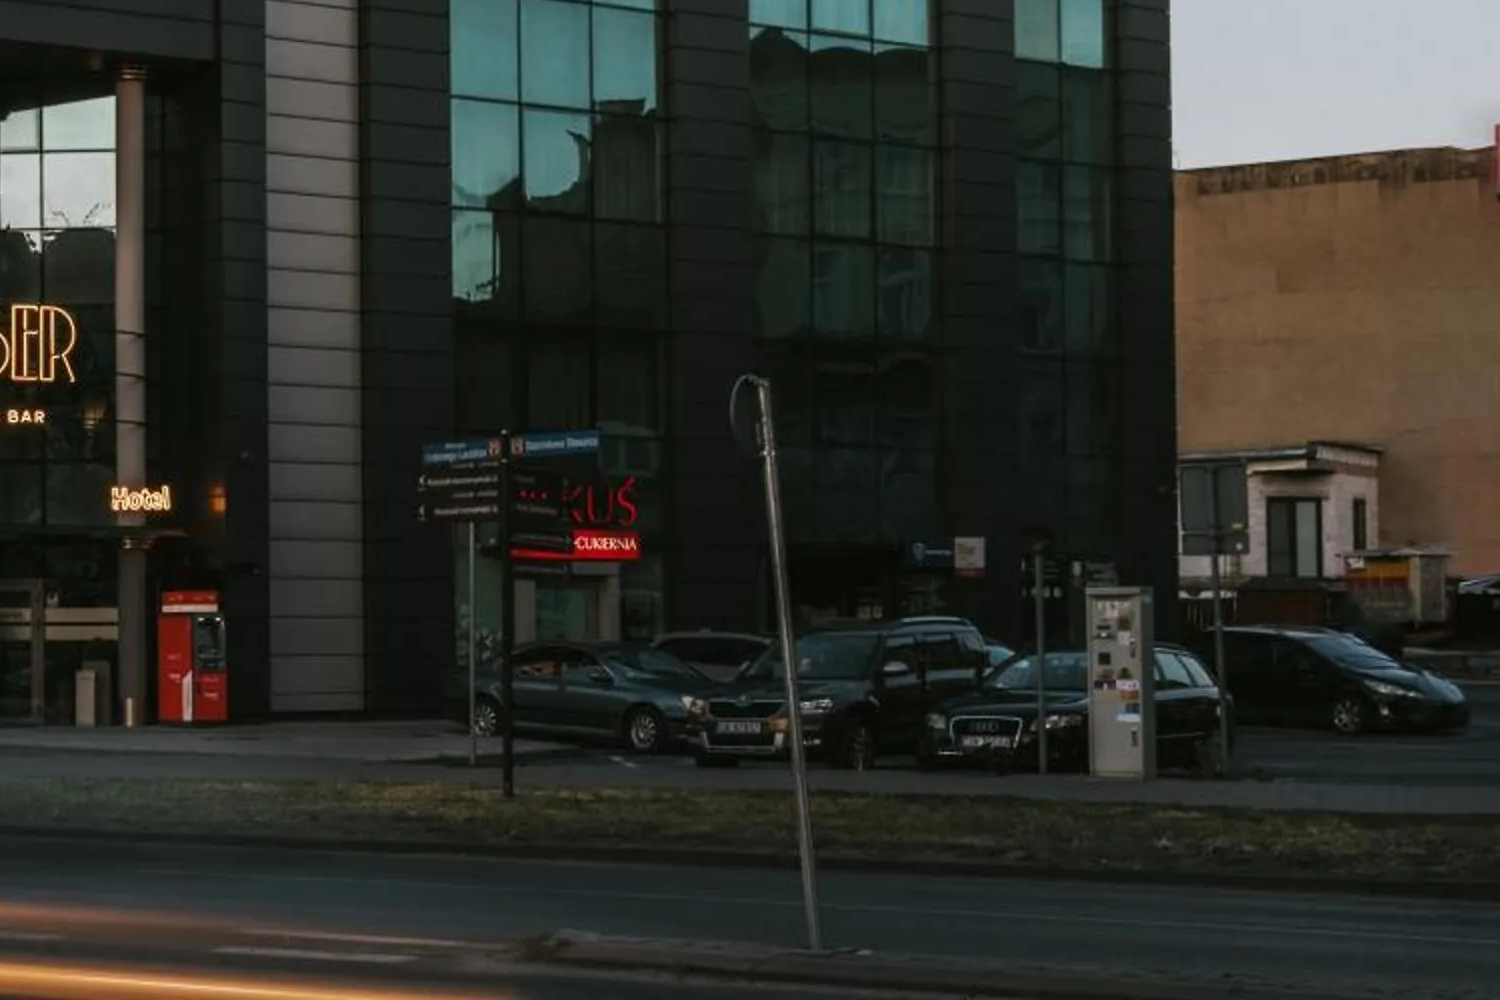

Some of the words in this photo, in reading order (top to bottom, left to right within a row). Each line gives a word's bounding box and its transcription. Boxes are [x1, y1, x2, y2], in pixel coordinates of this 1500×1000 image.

[7, 410, 47, 424] BAR
[111, 485, 171, 511] Hotel
[574, 535, 637, 551] CUKIERNIA
